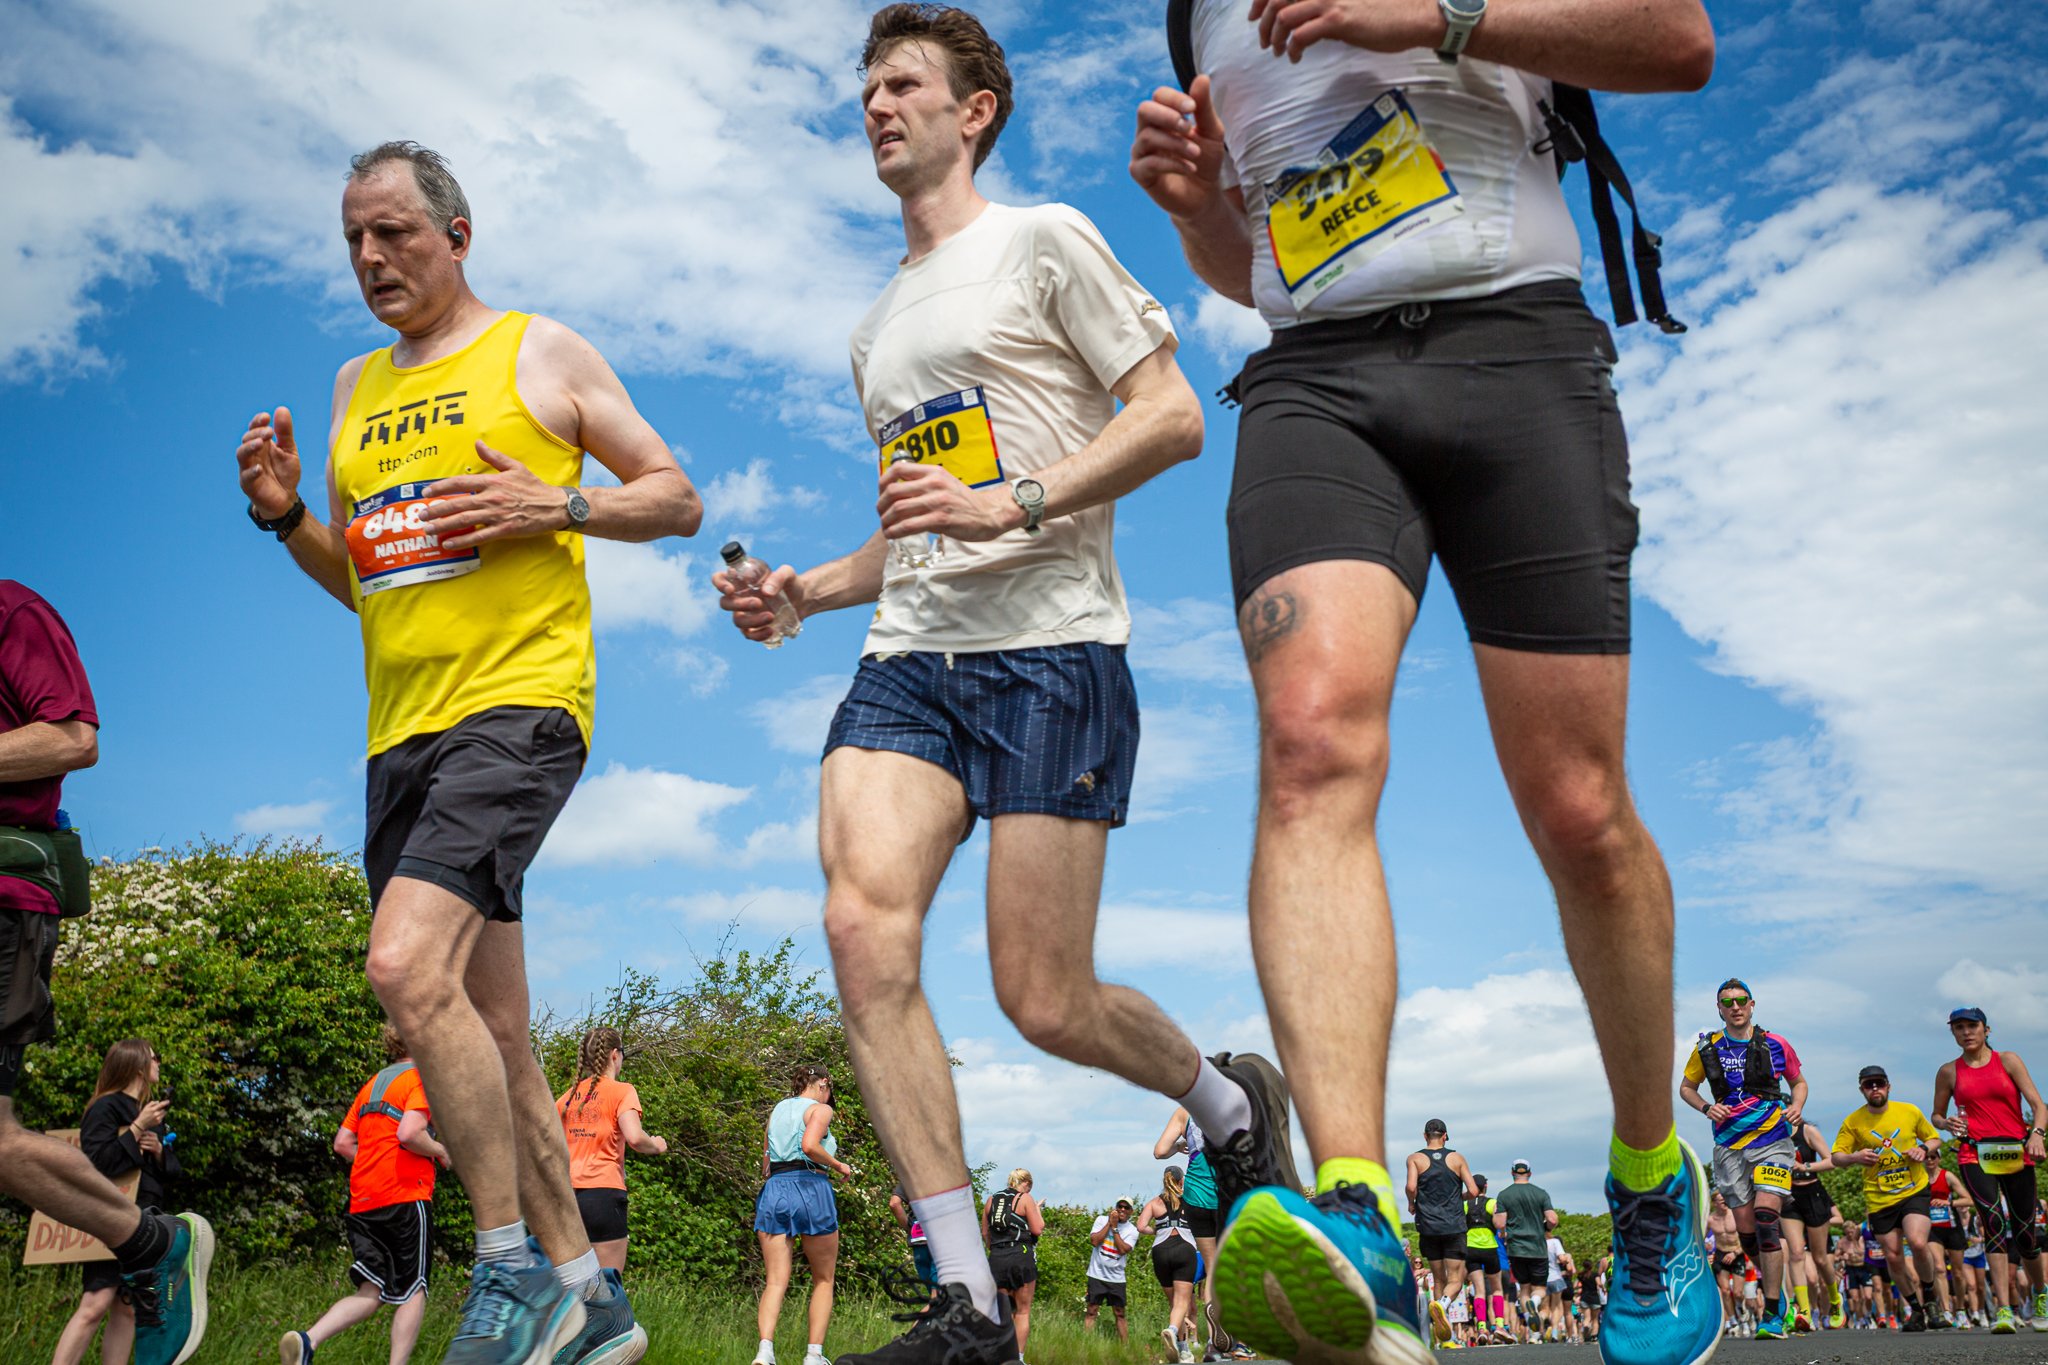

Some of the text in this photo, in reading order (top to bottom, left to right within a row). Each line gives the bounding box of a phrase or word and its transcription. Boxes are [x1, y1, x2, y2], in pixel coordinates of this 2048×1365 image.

[1320, 190, 1382, 236] REECE
[378, 444, 438, 473] ttp.com
[363, 499, 446, 539] 848
[374, 534, 439, 559] NATHAN
[1983, 1152, 2018, 1161] 86190
[1761, 1167, 1787, 1179] 3062
[33, 1221, 107, 1253] DADD
